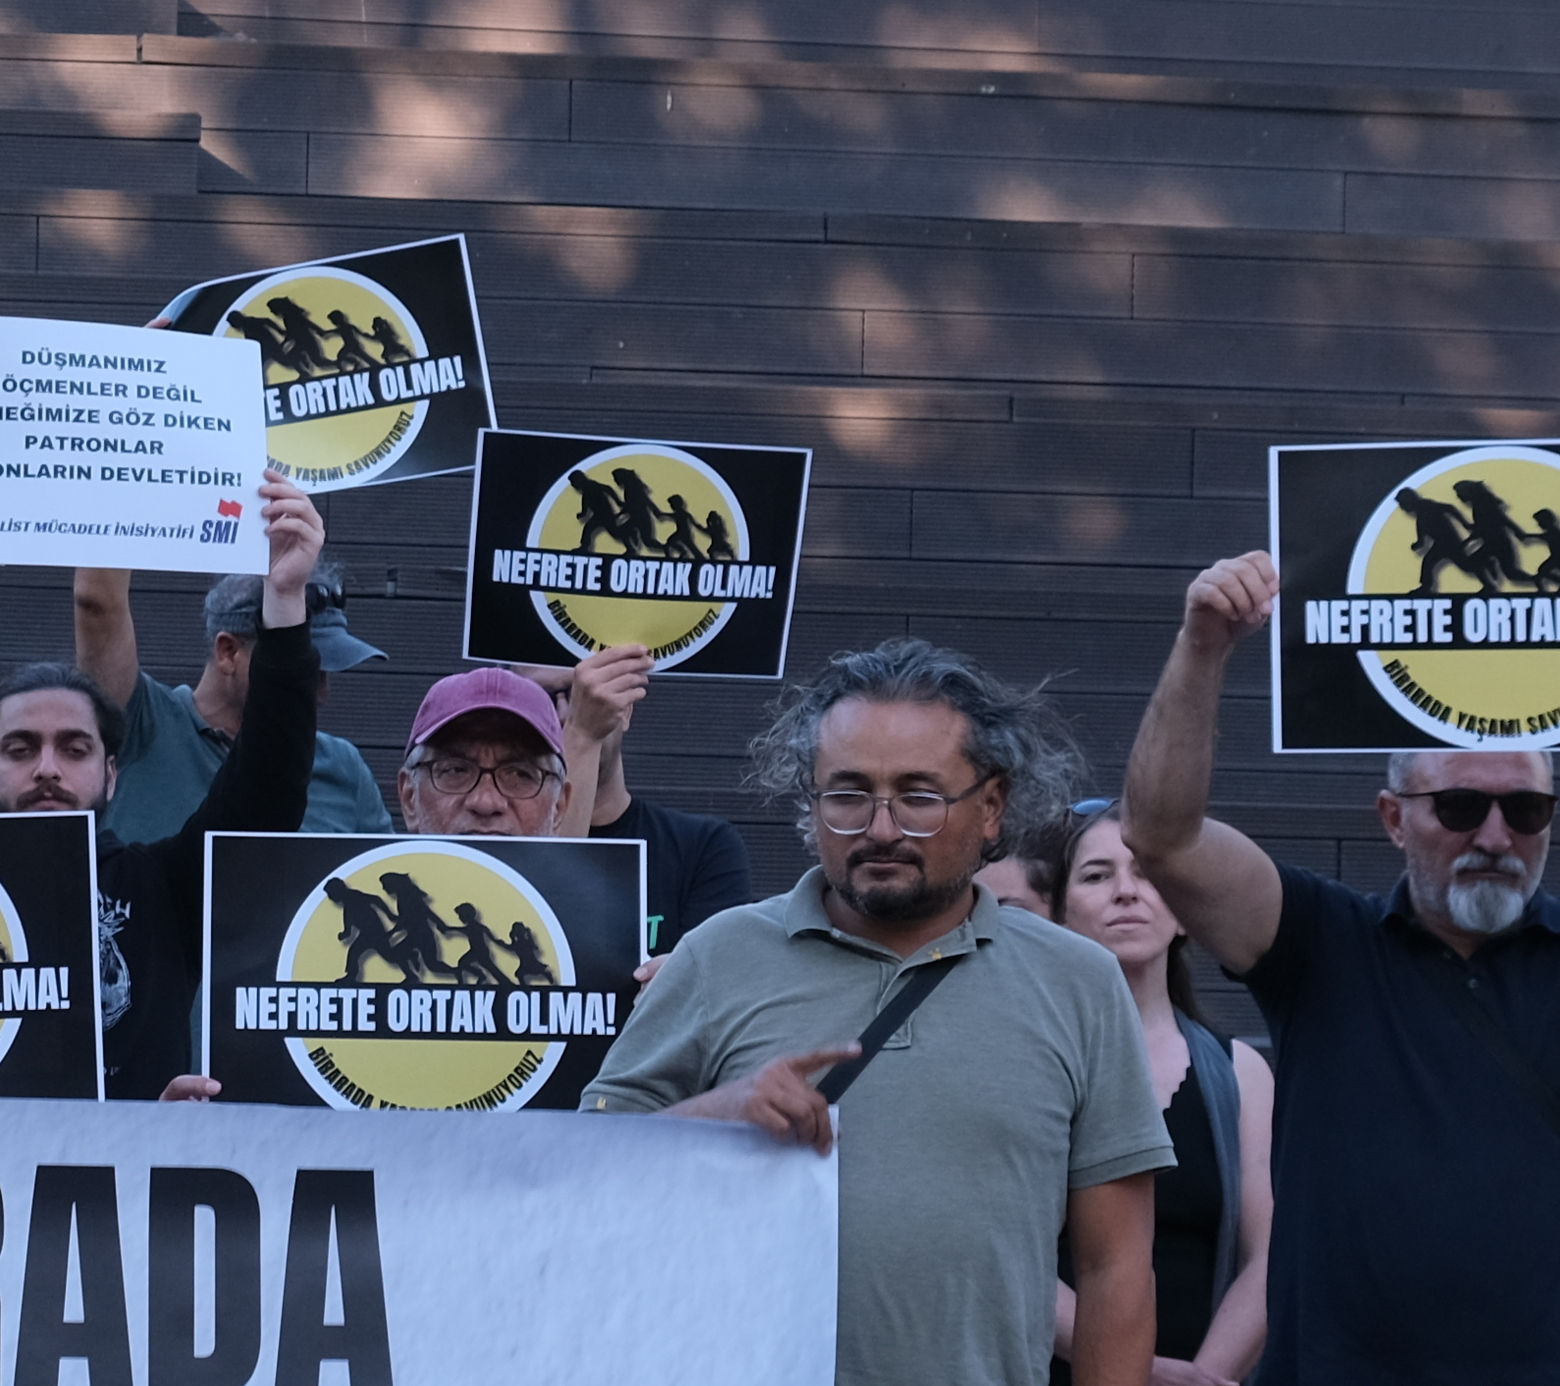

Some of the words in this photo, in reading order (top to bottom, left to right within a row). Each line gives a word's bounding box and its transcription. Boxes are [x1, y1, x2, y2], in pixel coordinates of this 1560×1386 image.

[21, 347, 167, 374] DÜŞMANIMIZ
[136, 383, 202, 404] DEĞİL
[288, 373, 376, 418] ORTAK
[380, 355, 467, 402] OLMA!
[108, 407, 156, 427] GÖZ
[163, 411, 232, 432] DİKEN
[24, 435, 164, 455] PATRONLAR
[295, 465, 345, 487] YAŞAMI
[346, 409, 415, 477] SAVUNUYORUZ
[100, 466, 243, 488] DEVLETİDİR!
[33, 518, 112, 536] MÜCADELE
[114, 521, 195, 540] İNİSİYATİFİ
[492, 548, 603, 591] NEFRETE
[610, 559, 692, 596] ORTAK
[698, 563, 777, 599] OLMA!
[1305, 598, 1453, 644] NEFRETE
[1455, 710, 1522, 742] YAŞAMI
[235, 986, 377, 1031] NEFRETE
[387, 989, 497, 1034] ORTAK
[507, 992, 617, 1036] OLMA!
[308, 1045, 375, 1110] BİRARADA
[445, 1049, 544, 1111] VUNUYORUZ
